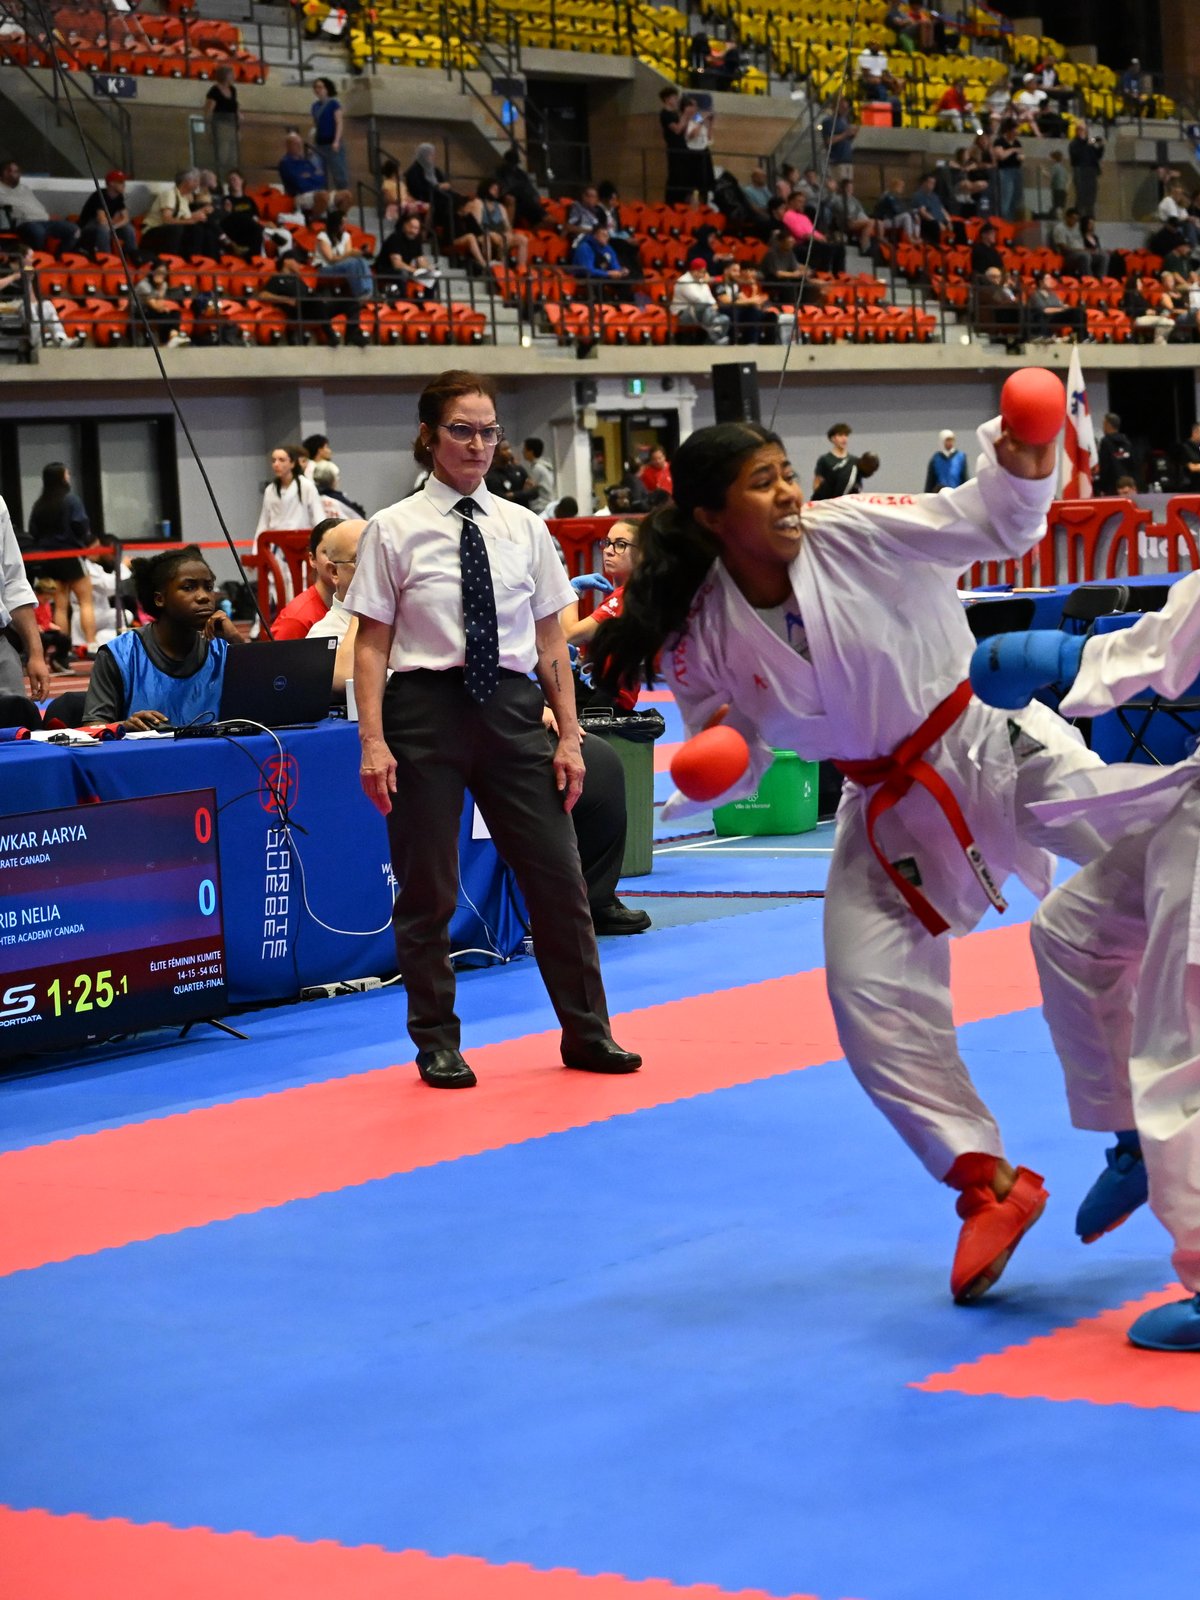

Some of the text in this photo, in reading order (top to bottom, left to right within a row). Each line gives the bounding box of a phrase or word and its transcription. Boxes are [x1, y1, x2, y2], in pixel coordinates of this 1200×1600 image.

[41, 825, 88, 846] AARYA
[195, 807, 211, 844] 0
[0, 853, 51, 869] RATE CANADA
[21, 904, 61, 925] NELIA
[198, 879, 216, 916] 0
[17, 928, 53, 943] ACADEMY
[54, 923, 85, 937] CANADA
[150, 950, 221, 972] ÉLITE FÉMININ KUMITE
[177, 967, 196, 980] 14-15
[208, 964, 218, 976] KG
[173, 977, 225, 995] QUARTER-FINAL
